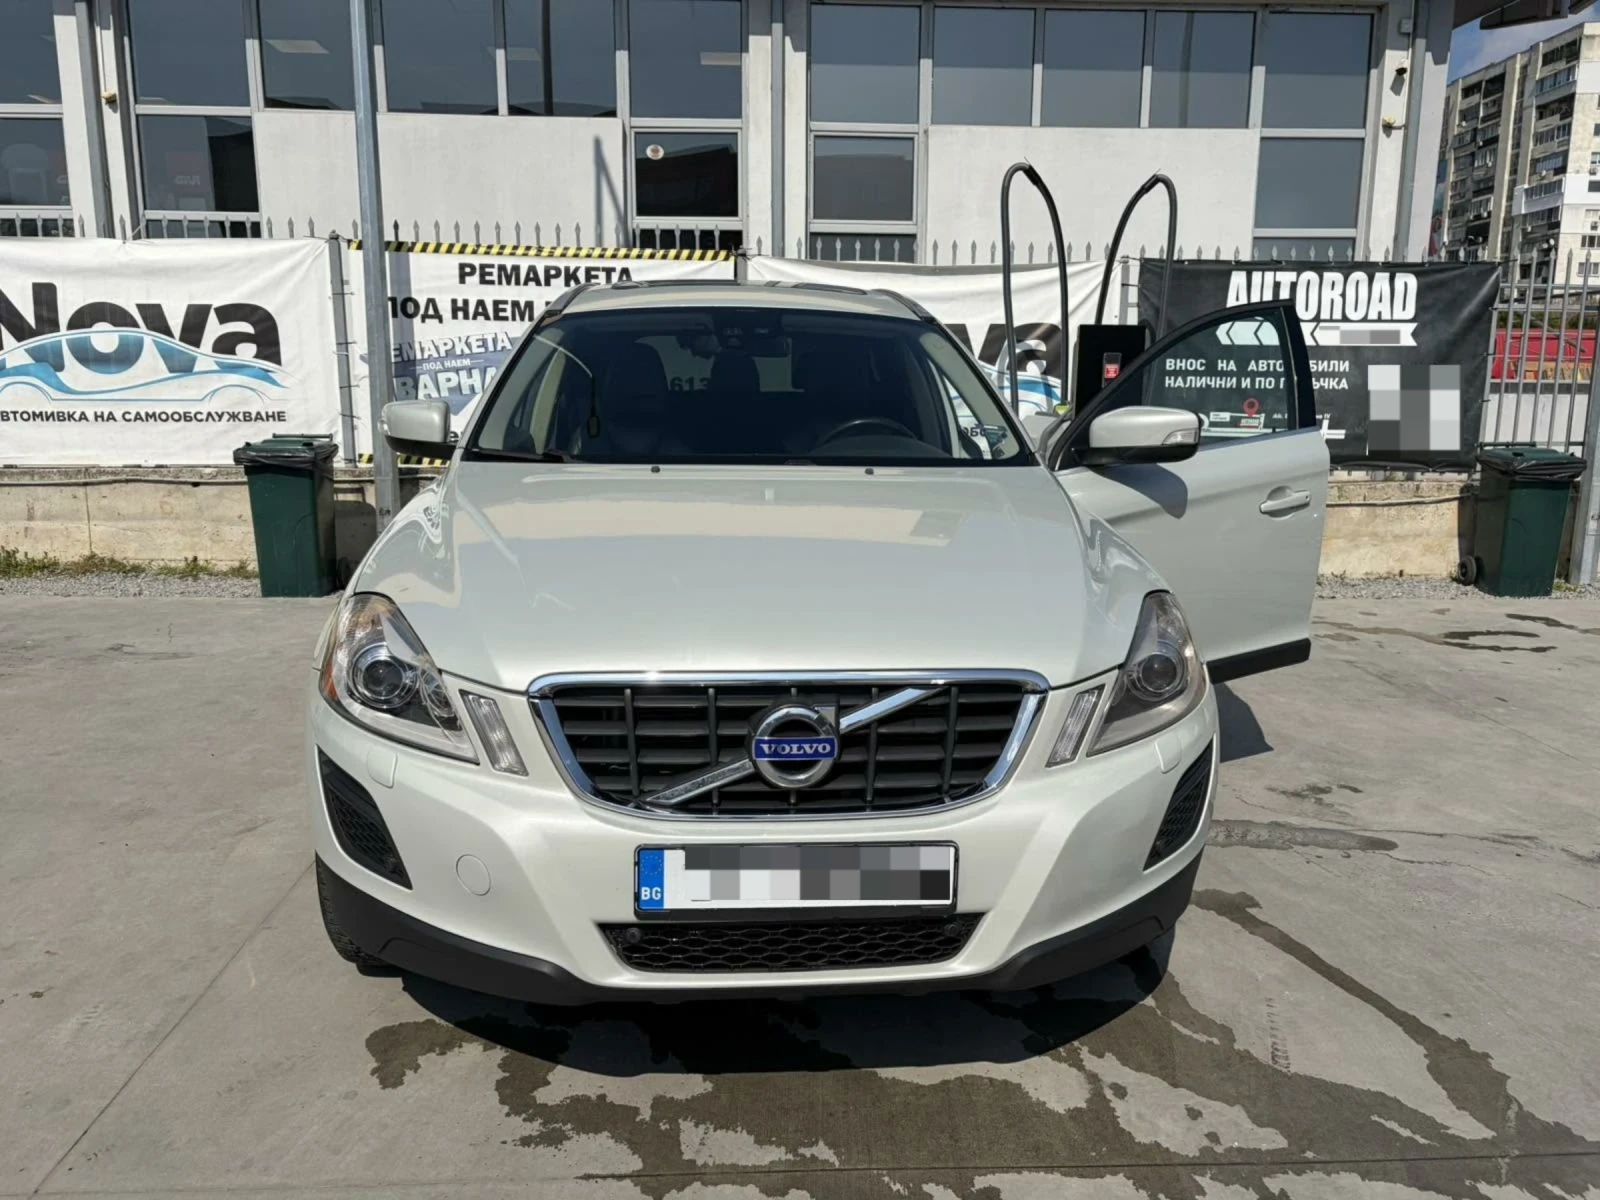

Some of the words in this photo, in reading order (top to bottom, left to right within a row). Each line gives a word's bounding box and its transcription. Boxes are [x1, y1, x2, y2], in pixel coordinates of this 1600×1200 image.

[458, 262, 633, 287] РЕМАРКЕТА
[1226, 270, 1418, 321] AUTOROAD
[451, 298, 535, 322] НАЕМ
[0, 282, 282, 375] Nova
[392, 332, 513, 362] ЕМАРКЕТА
[422, 361, 442, 371] ПОД
[444, 358, 471, 368] НАЕМ
[1165, 358, 1206, 371] ВНОС
[1217, 359, 1237, 372] НА
[1247, 359, 1350, 373] АВТОБИЛИ
[1165, 376, 1237, 389] НАЛИЧНИ
[1241, 377, 1251, 389] И
[1255, 377, 1275, 389] ПО
[0, 410, 89, 423] ВТОМИВКА
[94, 410, 117, 423] НА
[121, 410, 287, 423] САМООБСЛУЖВАНЕ
[760, 742, 831, 755] VOLVO
[641, 887, 662, 900] BG
